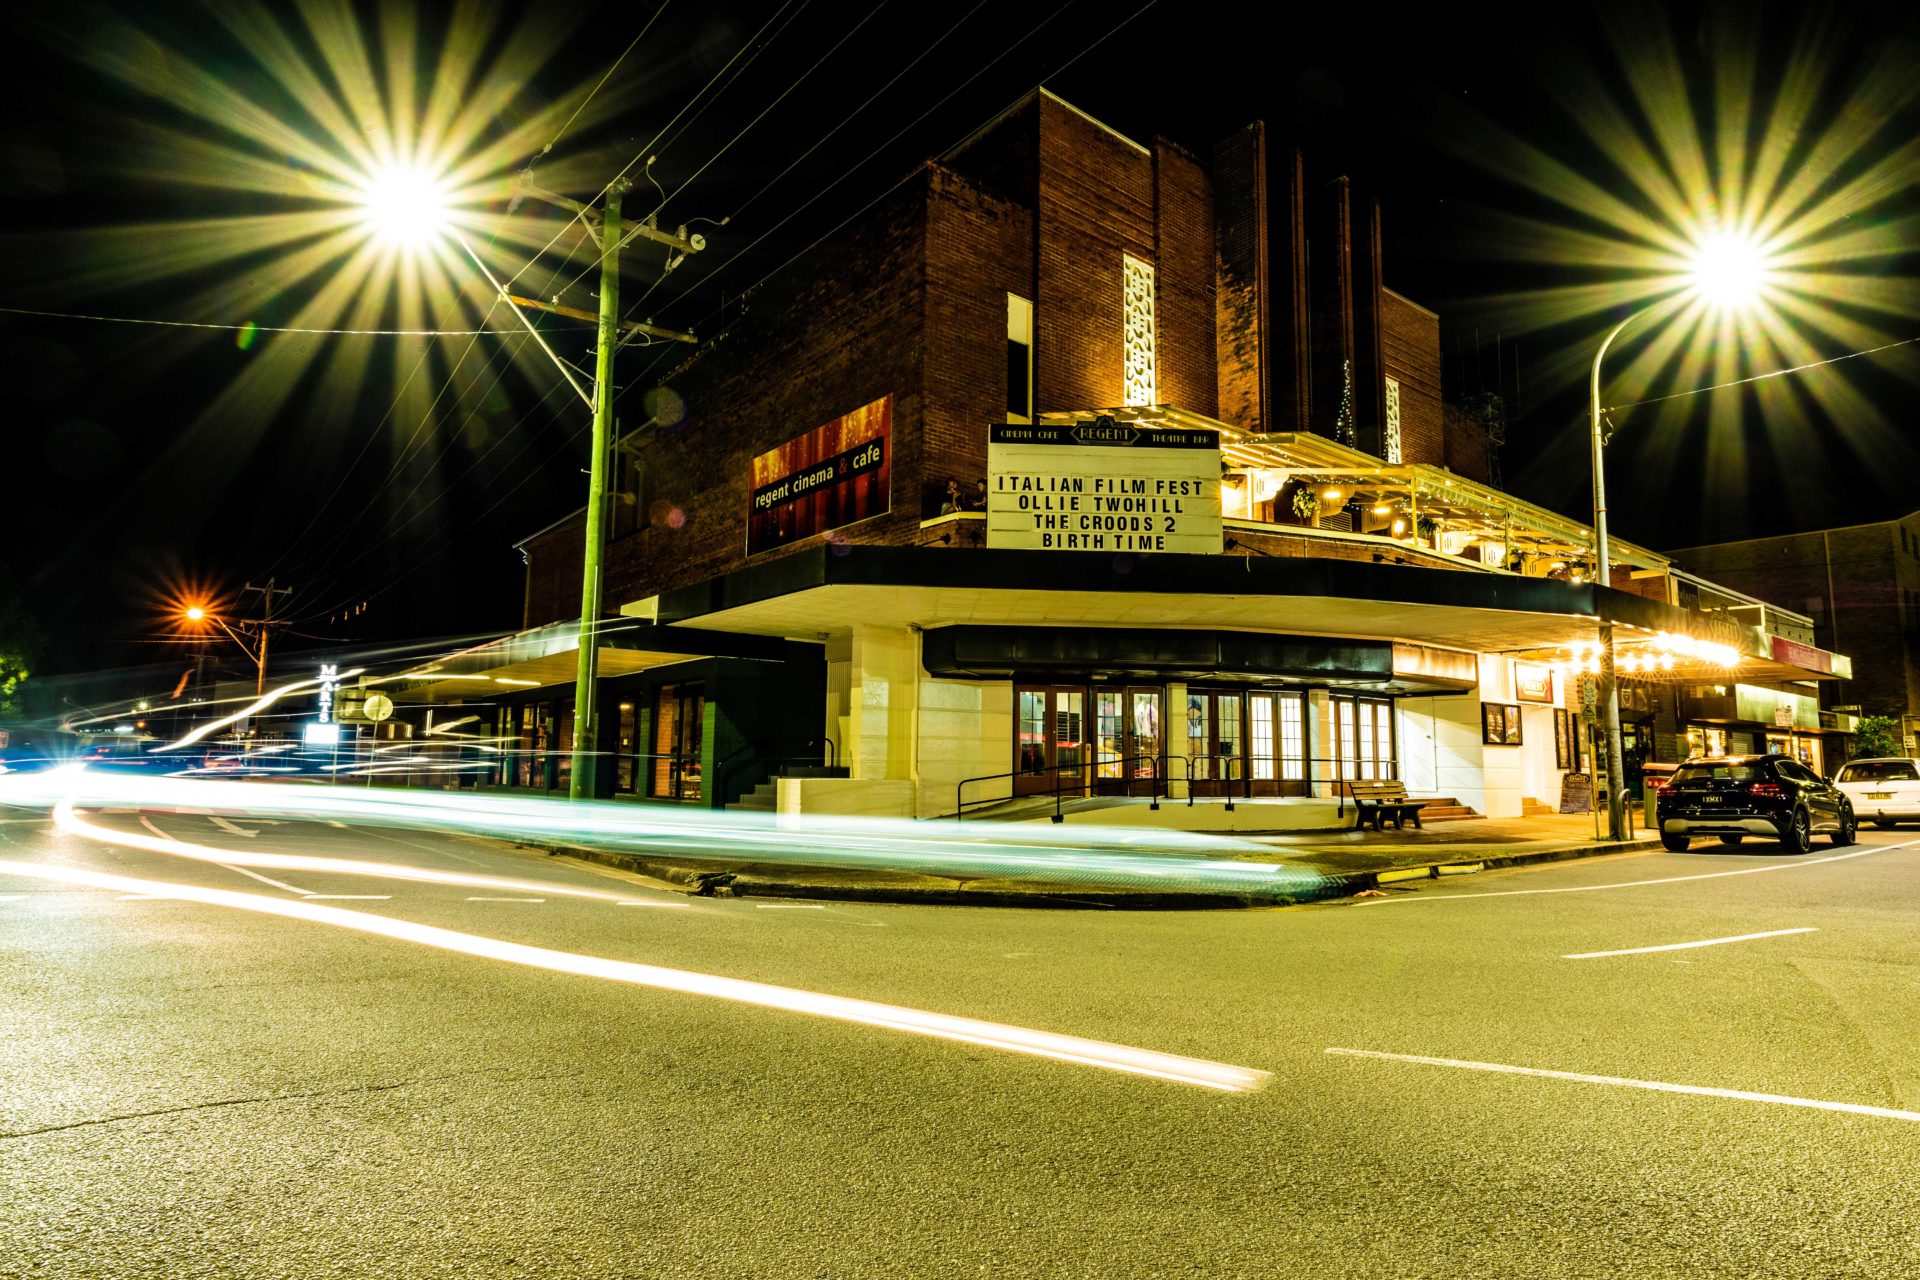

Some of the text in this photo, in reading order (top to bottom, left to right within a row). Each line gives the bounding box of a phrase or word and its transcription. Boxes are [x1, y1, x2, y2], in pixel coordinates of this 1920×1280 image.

[1000, 430, 1059, 439] CINEMA CAFE
[1080, 428, 1129, 440] REGENT
[1152, 434, 1209, 443] THEATRE BAR
[755, 445, 880, 508] regent cinema & cafe
[999, 476, 1203, 496] ITALIAN FILM FEST
[1018, 495, 1184, 513] OLLIE TWOHILL
[1034, 514, 1176, 533] THE CROODS 2
[1043, 533, 1165, 550] BIRTH TIME
